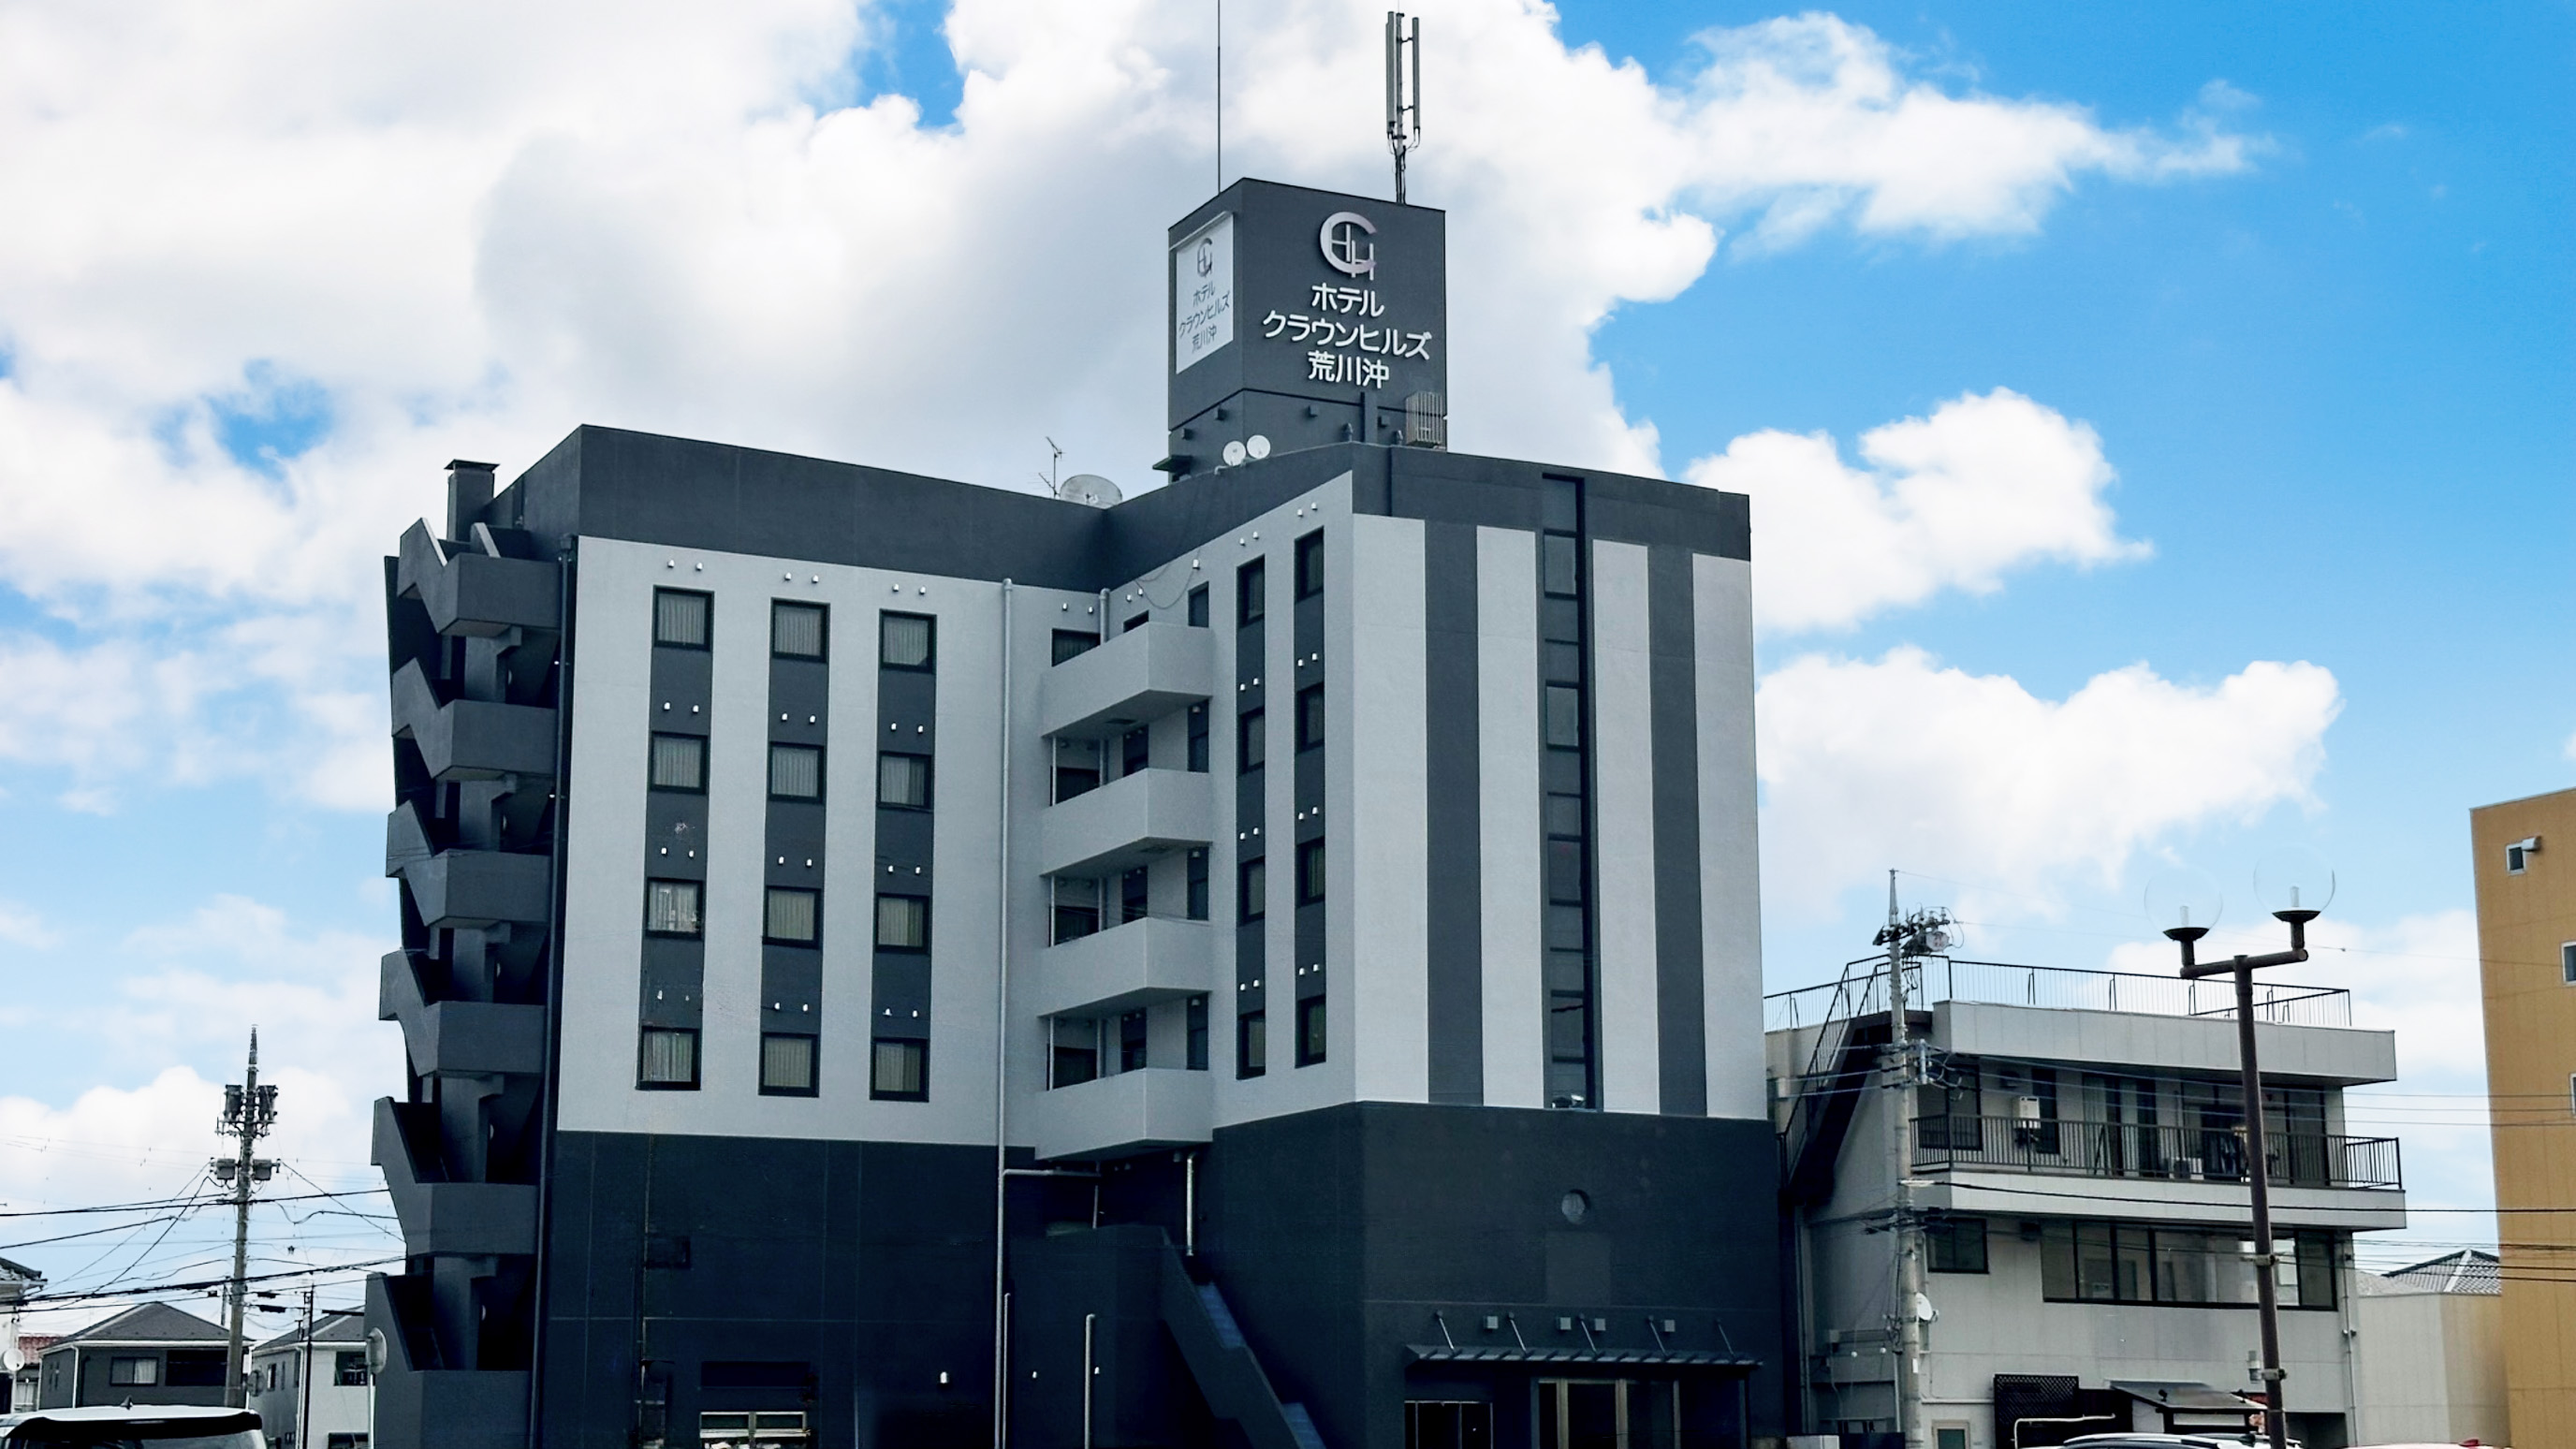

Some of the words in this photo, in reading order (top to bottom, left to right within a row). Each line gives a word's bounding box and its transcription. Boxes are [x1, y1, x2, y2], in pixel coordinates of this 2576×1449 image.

[1193, 281, 1216, 307] ホテル
[1311, 283, 1385, 317] ホテル
[1178, 290, 1231, 339] クラウンヒルズ
[1263, 310, 1433, 360] クラウンヒルズ
[1308, 350, 1390, 389] 荒川沖
